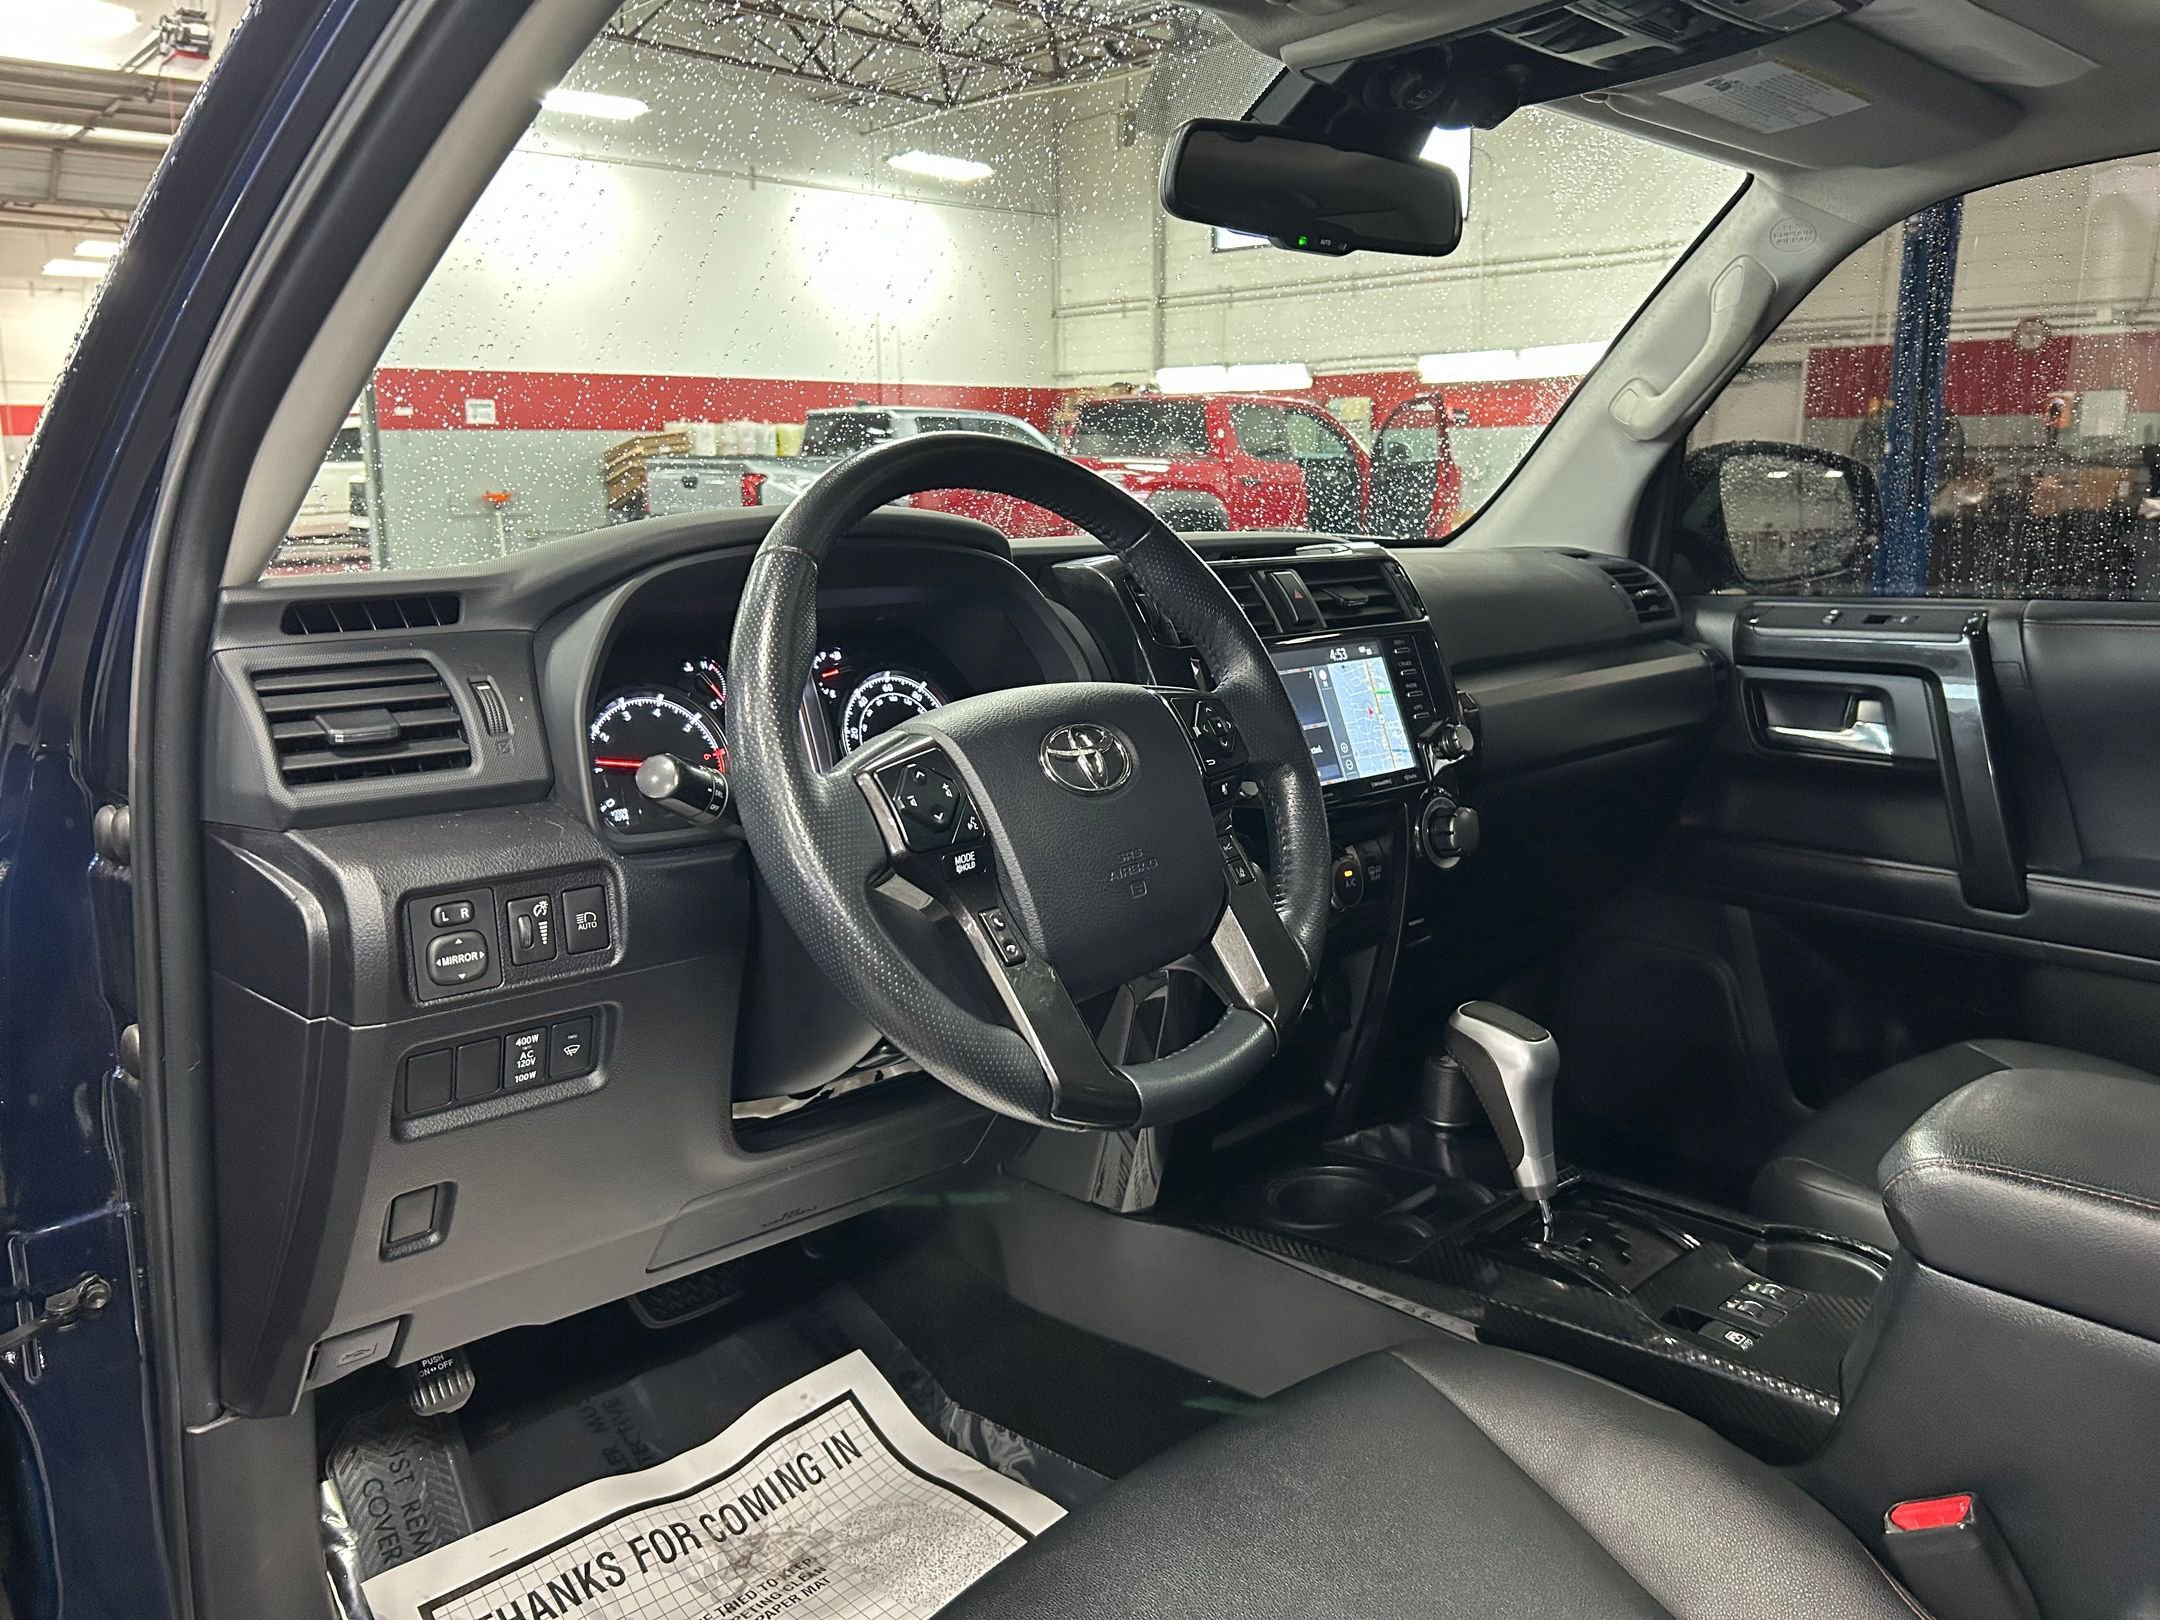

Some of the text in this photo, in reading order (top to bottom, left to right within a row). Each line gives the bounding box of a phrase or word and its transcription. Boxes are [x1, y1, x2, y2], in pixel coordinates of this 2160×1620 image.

[622, 710, 632, 722] 3
[653, 708, 662, 718] 4
[600, 732, 610, 743] 2
[850, 727, 859, 740] 20
[709, 803, 720, 812] OFF
[955, 851, 976, 865] MODE
[441, 907, 470, 922] L R
[577, 921, 598, 931] AUTO
[441, 951, 479, 967] MIRROR
[515, 1034, 539, 1046] 400W
[520, 1050, 534, 1060] AC
[517, 1057, 536, 1068] 120V
[515, 1071, 536, 1083] 100W
[421, 1354, 445, 1367] PUSH
[437, 1359, 454, 1370] OFF
[627, 1521, 704, 1574] FOR
[699, 1452, 827, 1543] COMING
[821, 1429, 865, 1471] IN
[363, 1478, 402, 1565] COVER
[783, 1566, 828, 1592] CLEAN
[714, 1590, 758, 1618] TRIED
[757, 1578, 779, 1592] TO
[778, 1558, 813, 1581] KEEP
[801, 1575, 832, 1597] MAT
